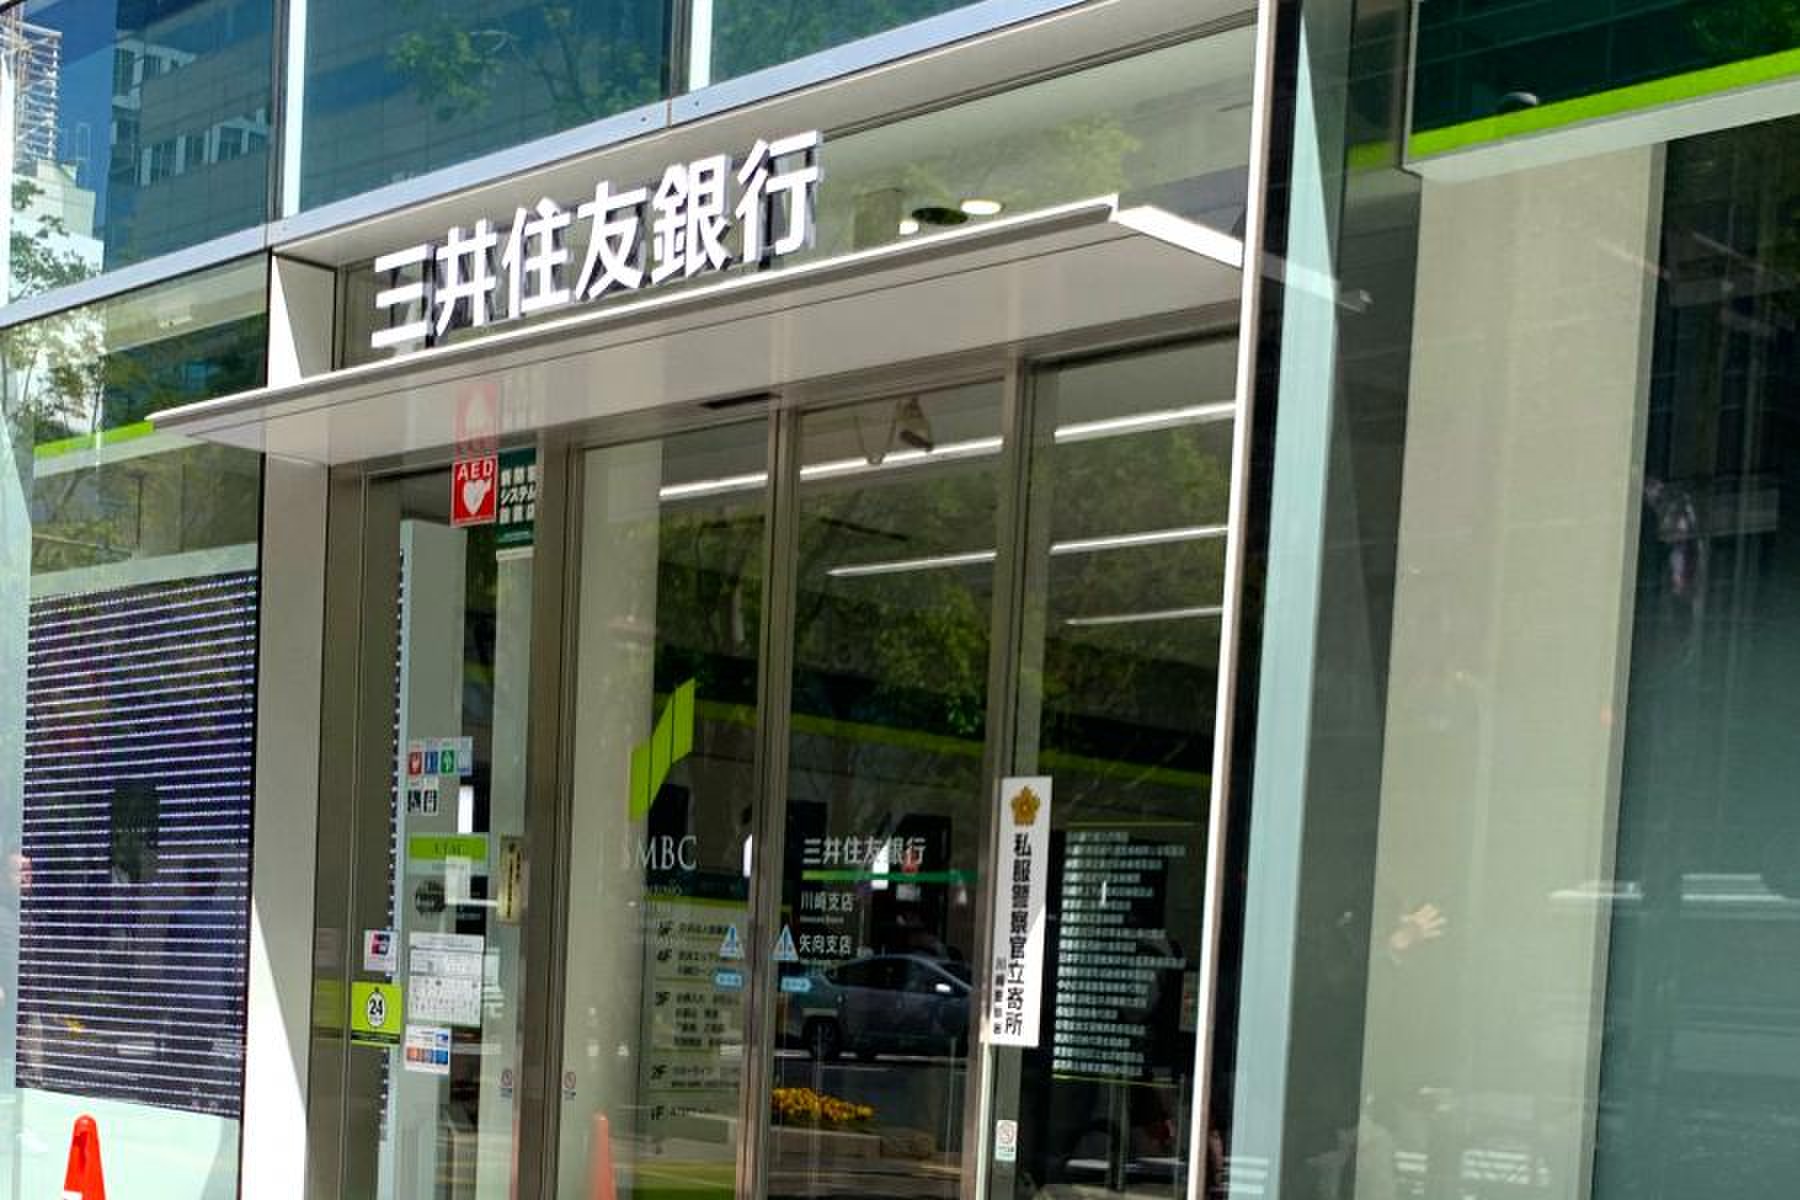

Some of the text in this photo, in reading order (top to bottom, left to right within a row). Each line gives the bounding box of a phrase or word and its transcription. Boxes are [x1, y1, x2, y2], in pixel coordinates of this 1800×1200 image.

[370, 130, 823, 349] 三井住友銀行
[457, 460, 494, 481] AED
[802, 836, 927, 866] 三井住友銀行
[1004, 833, 1032, 1037] 私服警察官立寄所
[369, 998, 383, 1016] 24
